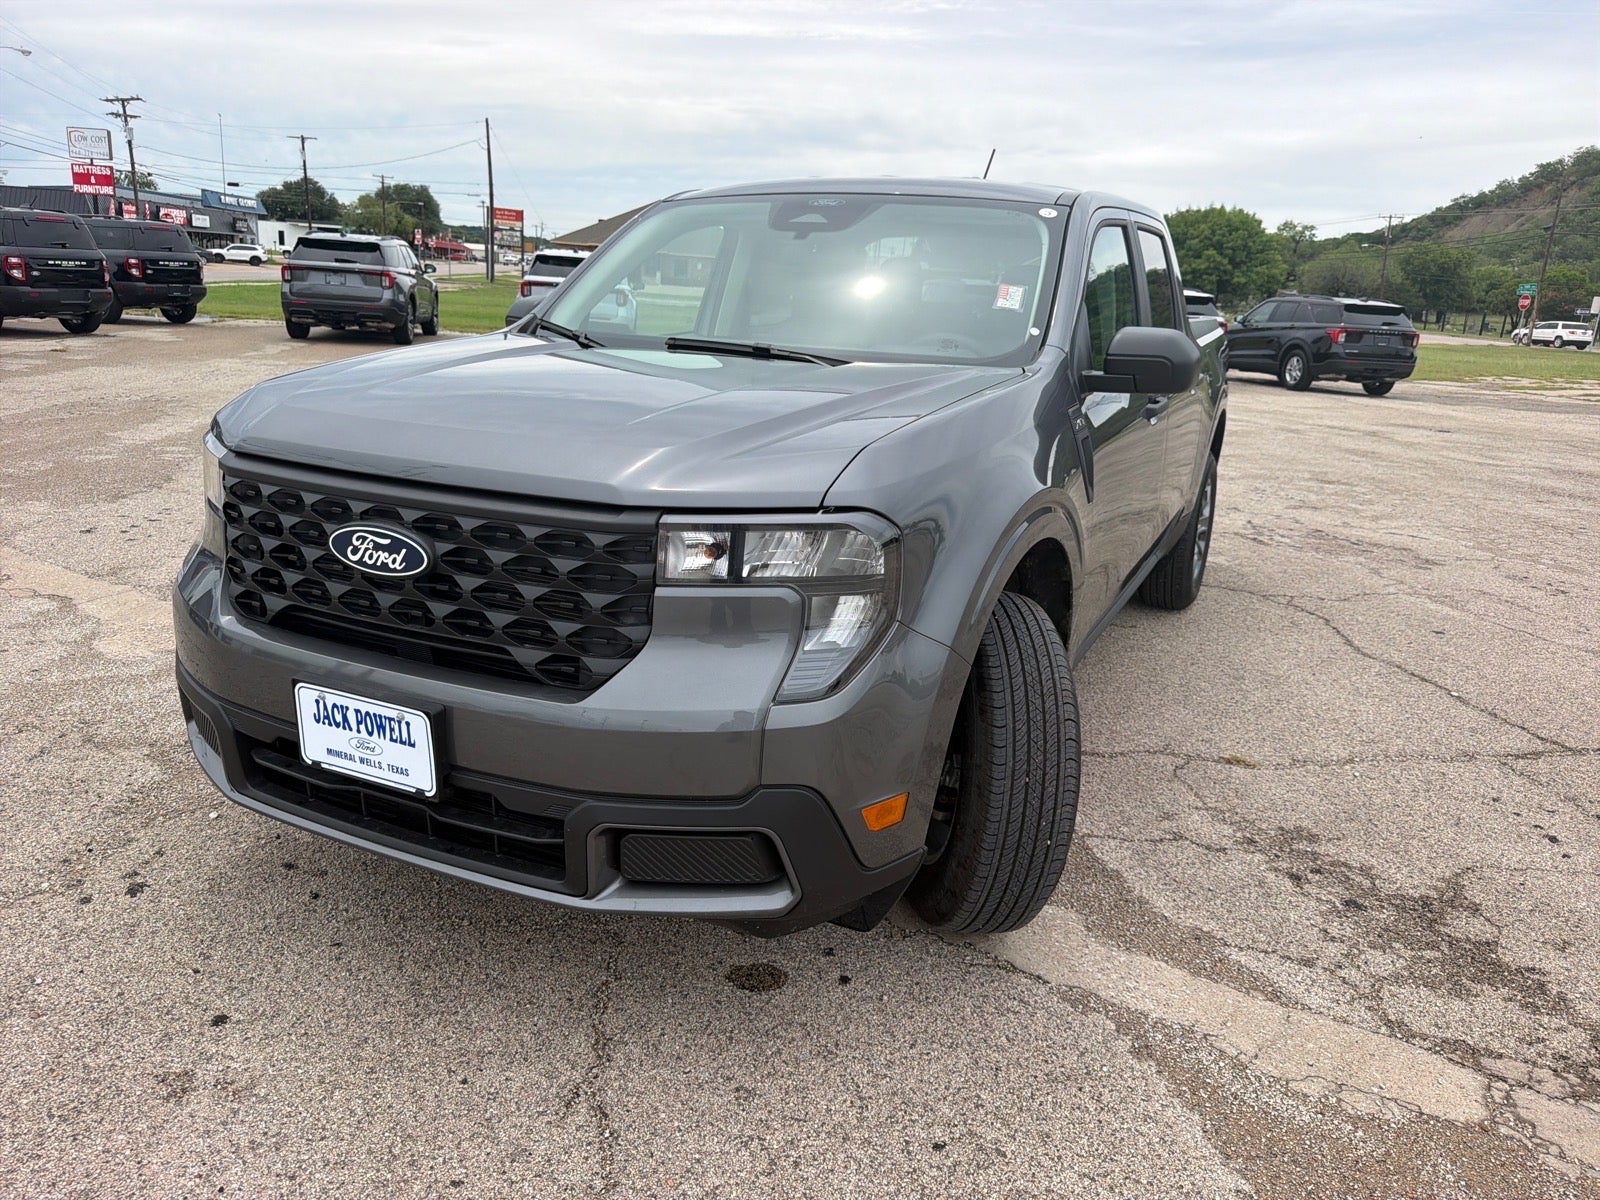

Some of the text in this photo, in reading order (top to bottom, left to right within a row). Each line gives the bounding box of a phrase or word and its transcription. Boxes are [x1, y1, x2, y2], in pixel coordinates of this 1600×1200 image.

[74, 134, 107, 144] LOW COST
[73, 165, 110, 175] MATTRESS
[90, 175, 96, 184] &
[74, 184, 114, 195] FURNITURE
[160, 207, 187, 217] MATTRESS
[347, 532, 408, 570] Ford
[313, 698, 416, 749] JACK POWELL
[355, 739, 377, 753] Ford
[326, 747, 410, 777] MINERAL WELLS, TEXAS
